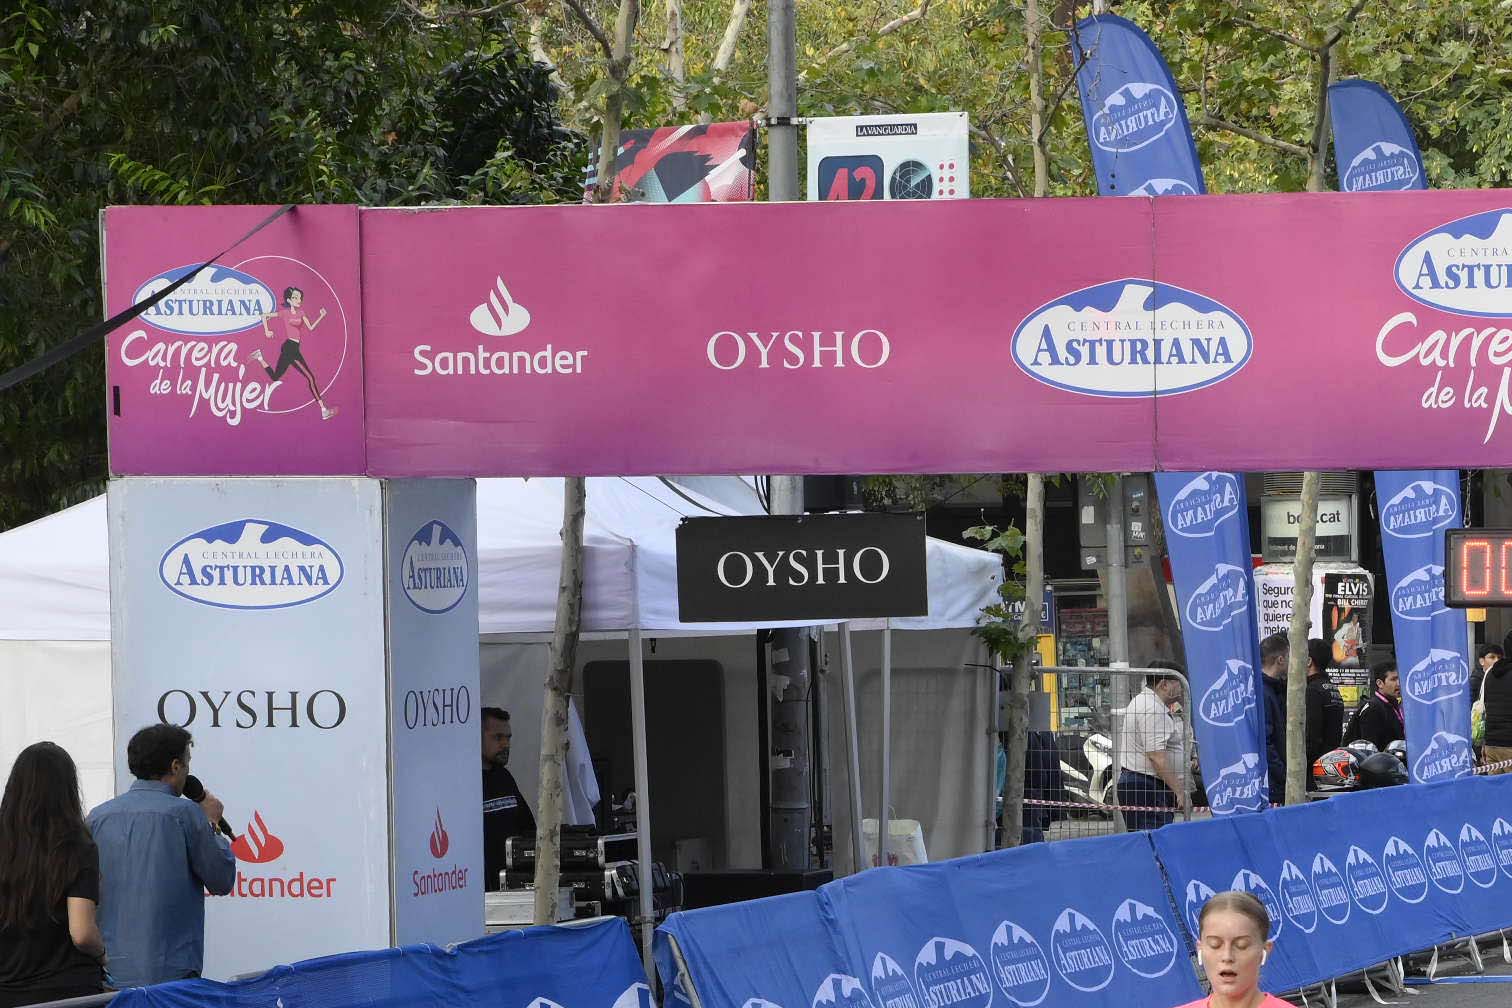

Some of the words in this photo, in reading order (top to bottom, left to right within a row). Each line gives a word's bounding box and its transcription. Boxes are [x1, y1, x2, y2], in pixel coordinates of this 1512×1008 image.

[1067, 319, 1144, 332] CENTRAL
[1149, 318, 1225, 331] LECHERA
[120, 329, 239, 368] Carrera
[413, 345, 587, 375] Santander
[707, 329, 890, 370] OYSHO
[1030, 323, 1234, 366] ASTURIANA
[150, 369, 172, 395] de
[176, 367, 193, 395] la
[189, 364, 283, 426] Mujer
[1422, 371, 1455, 409] de
[1463, 368, 1488, 409] la
[174, 553, 330, 587] ASTURIANA
[202, 551, 259, 561] CENTRAL
[266, 551, 324, 561] LECHERA
[406, 555, 465, 591] ASTURIANA
[717, 547, 890, 588] OYSHO
[1263, 599, 1279, 611] que
[1338, 582, 1368, 595] ELVIS
[157, 689, 347, 730] OYSHO
[404, 685, 471, 730] OYSHO
[412, 865, 468, 898] Santander
[1058, 942, 1112, 975] ASTURIANA
